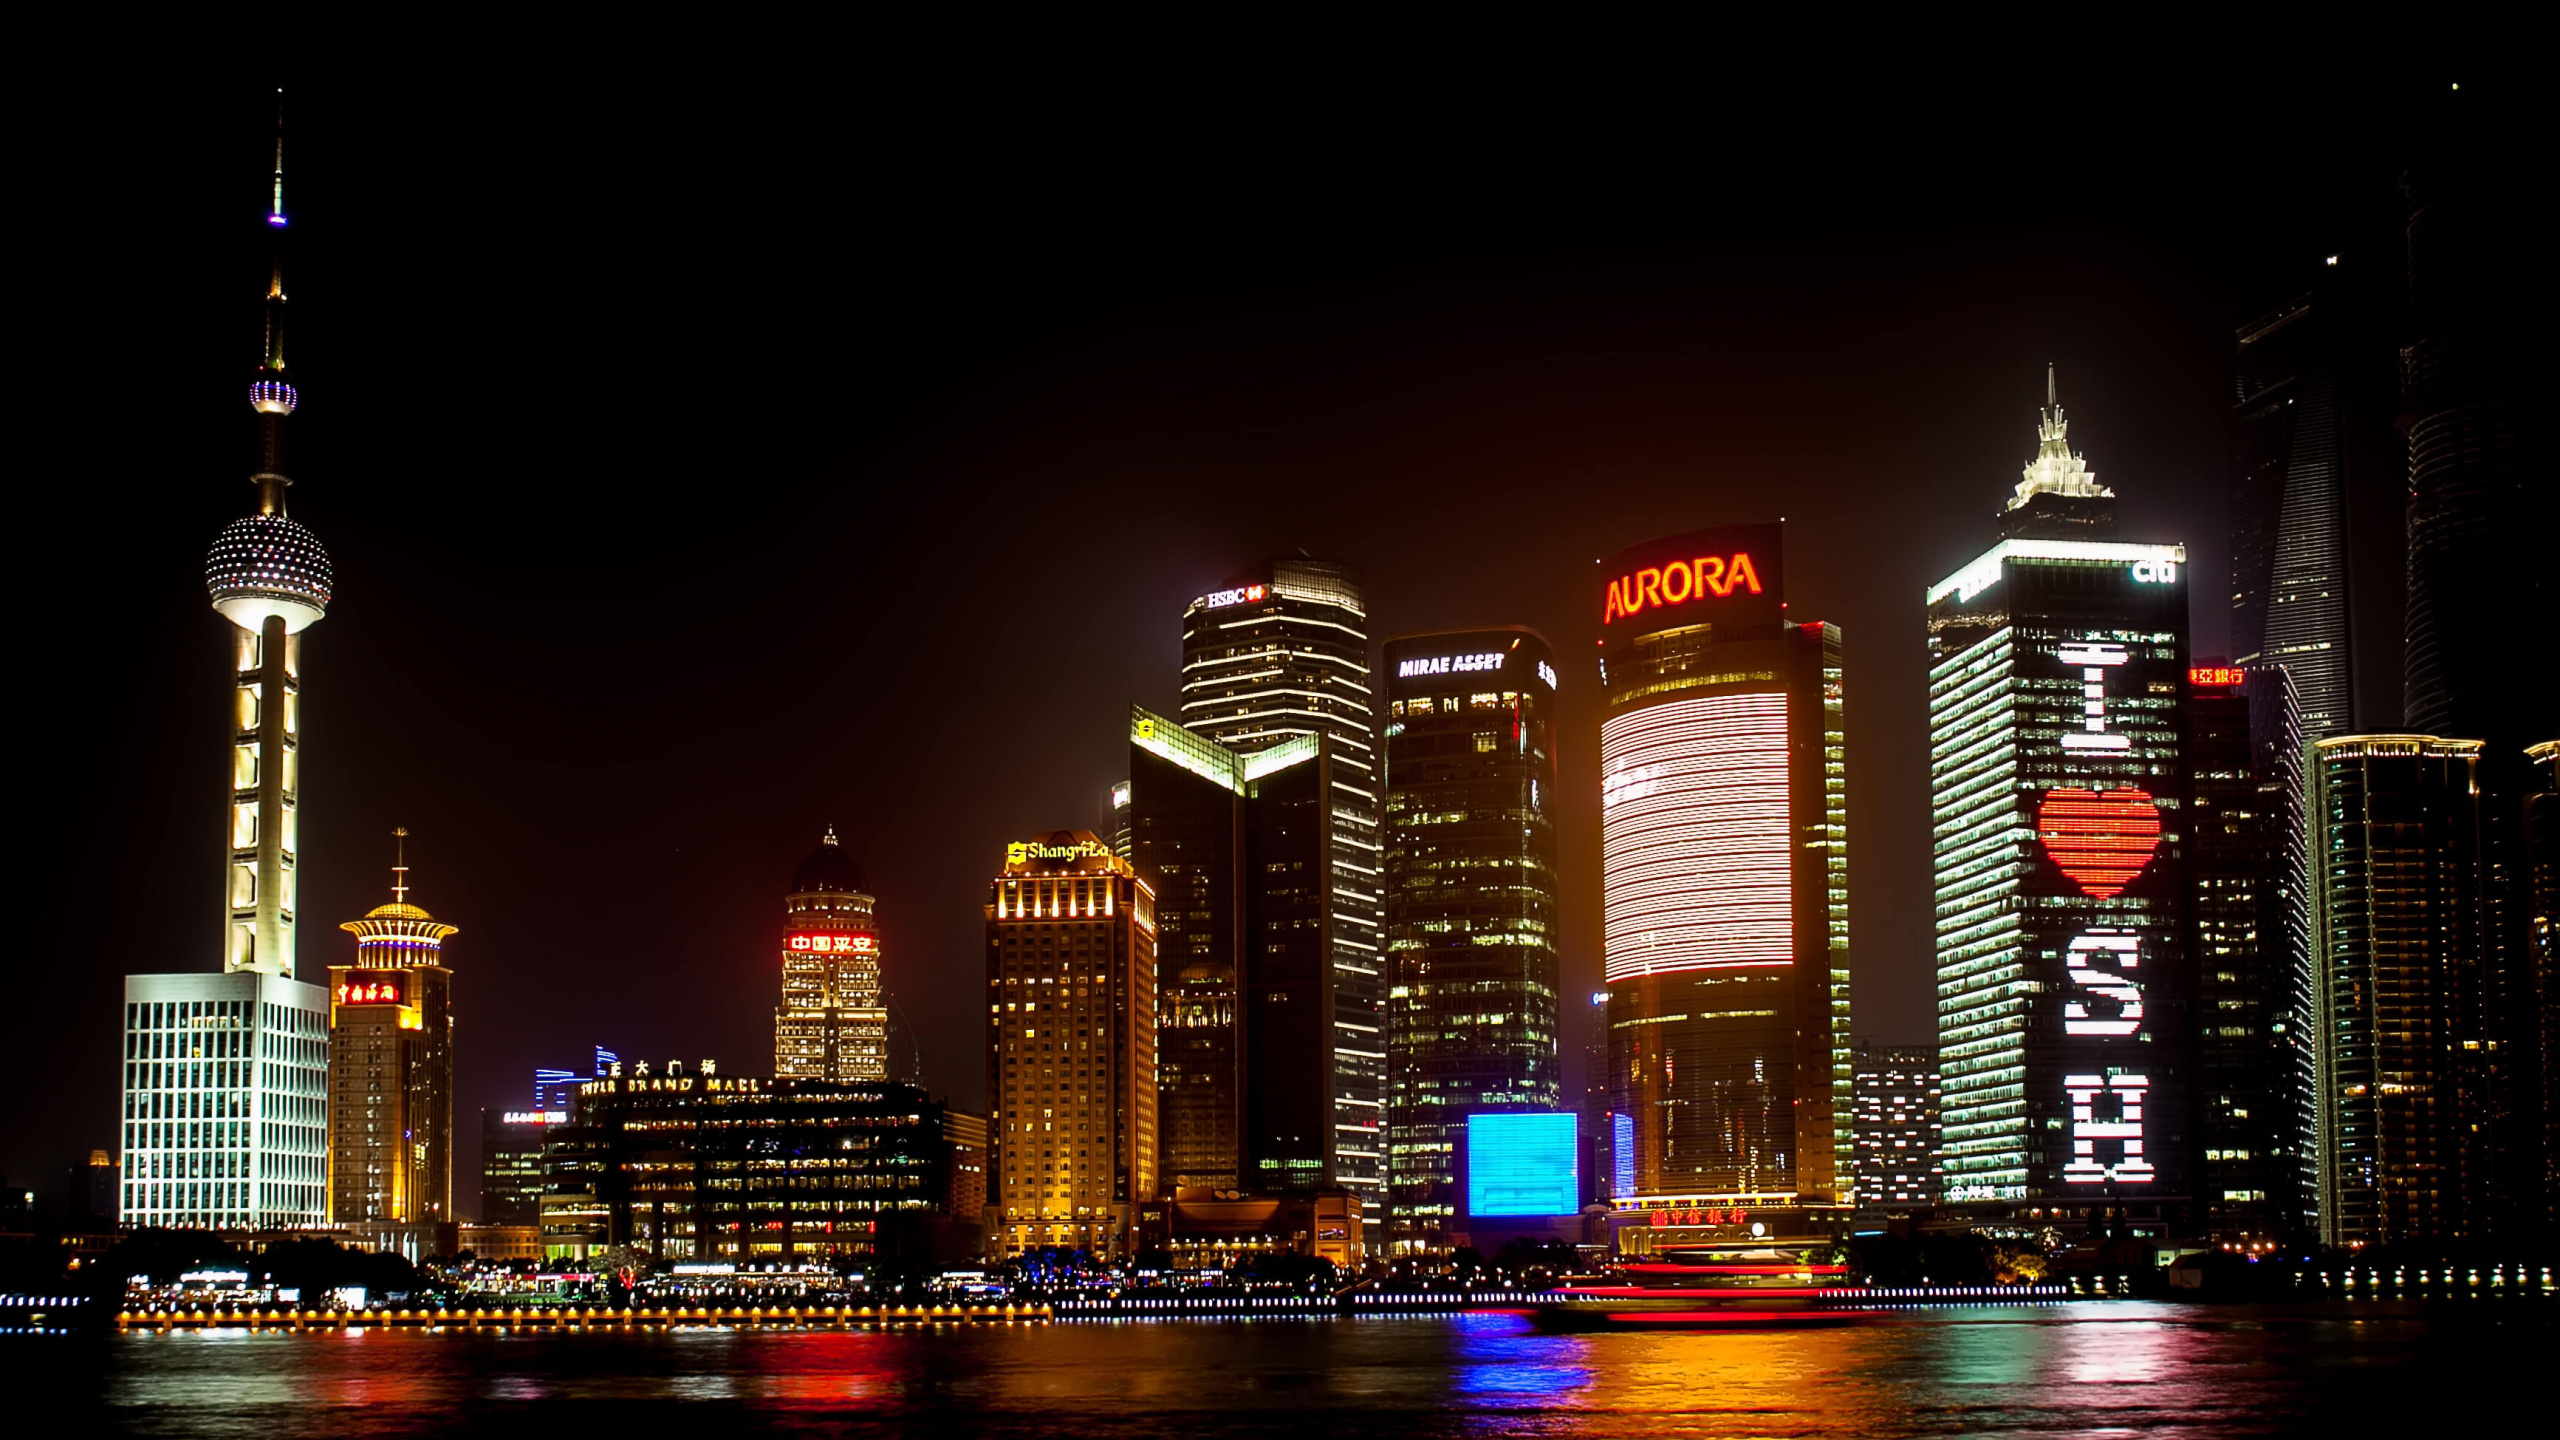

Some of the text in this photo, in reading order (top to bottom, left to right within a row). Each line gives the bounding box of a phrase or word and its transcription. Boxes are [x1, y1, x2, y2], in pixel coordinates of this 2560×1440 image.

[2132, 558, 2176, 583] citi
[1207, 588, 1245, 608] HSBC
[1604, 553, 1763, 625] AURORA
[1399, 653, 1505, 678] MIRAE ASSET
[791, 935, 871, 952] 中国平安
[610, 1059, 716, 1077] 正大广场
[628, 1078, 693, 1091] BRAND
